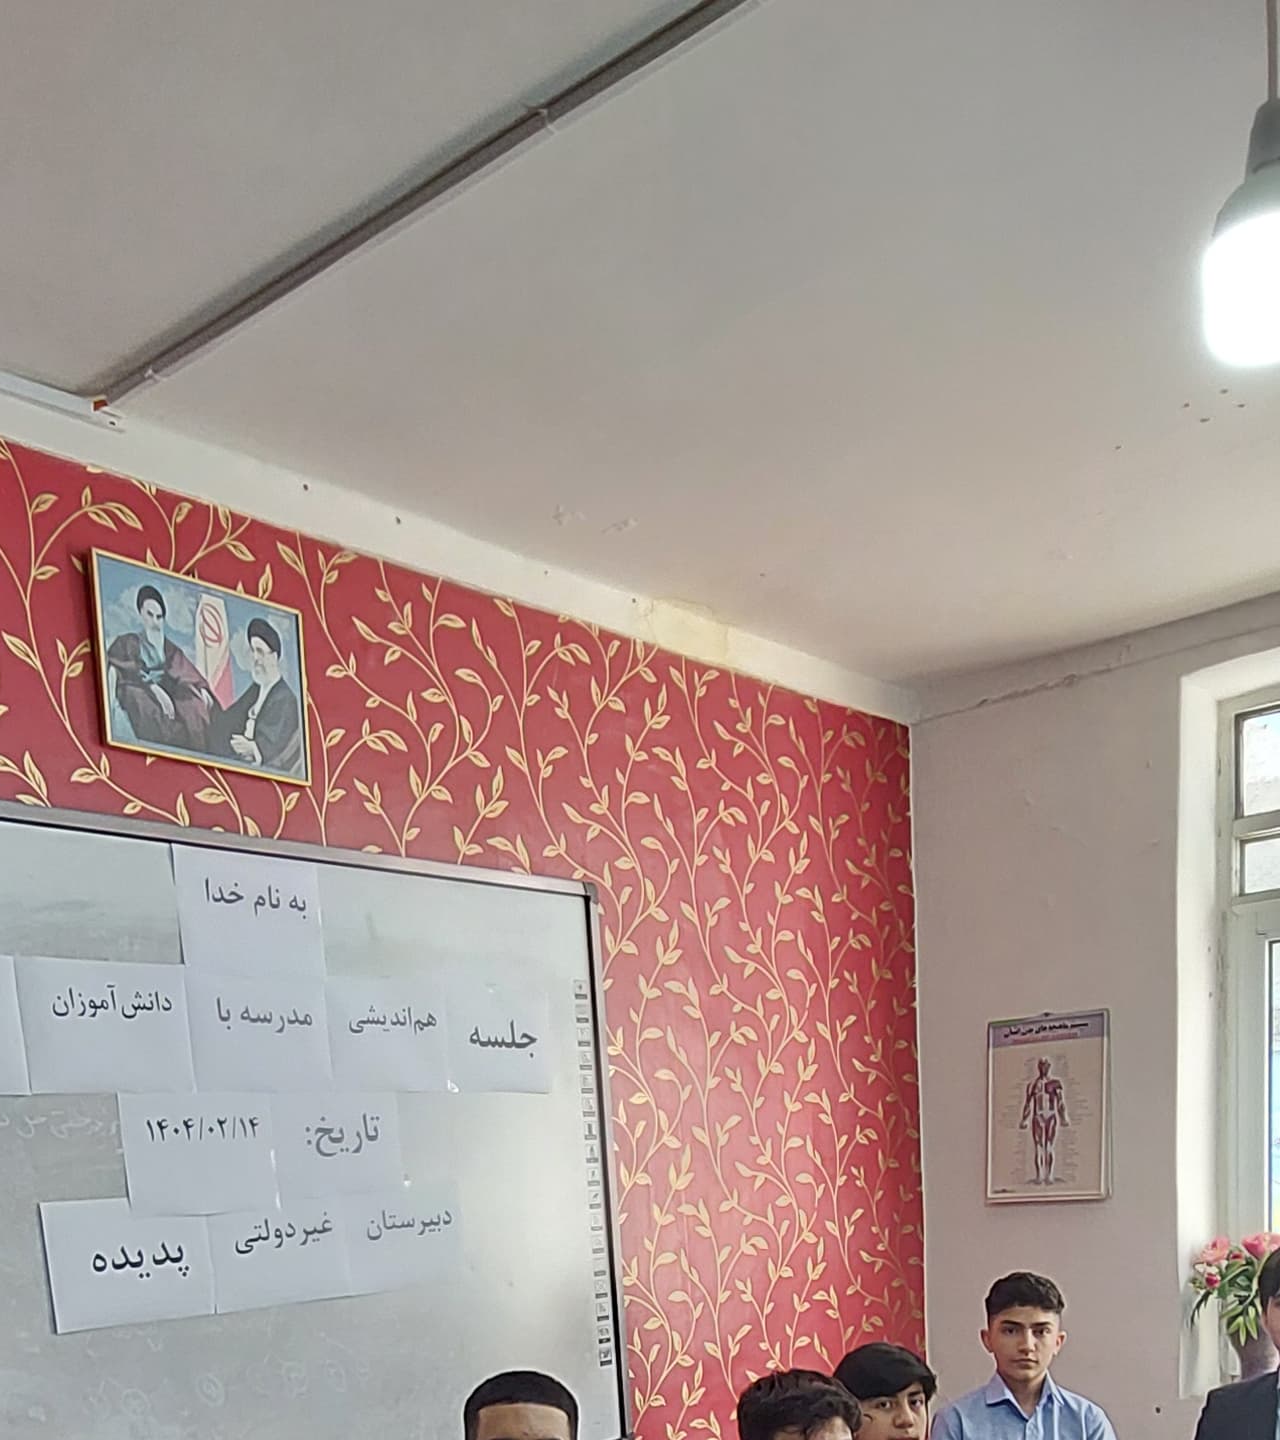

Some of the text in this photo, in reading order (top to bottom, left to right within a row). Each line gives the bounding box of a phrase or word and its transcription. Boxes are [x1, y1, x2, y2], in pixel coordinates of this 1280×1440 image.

[204, 877, 307, 920] به نام خدا
[216, 996, 232, 1031] با
[239, 1003, 314, 1033] مدرسه
[468, 1019, 538, 1058] جلسه
[145, 1115, 260, 1142] ۱۴۰۴/۰۲/۱۴
[305, 1112, 381, 1158] تاریخ:
[90, 1208, 453, 1278] دبیرستان غیردولتی پدیده
